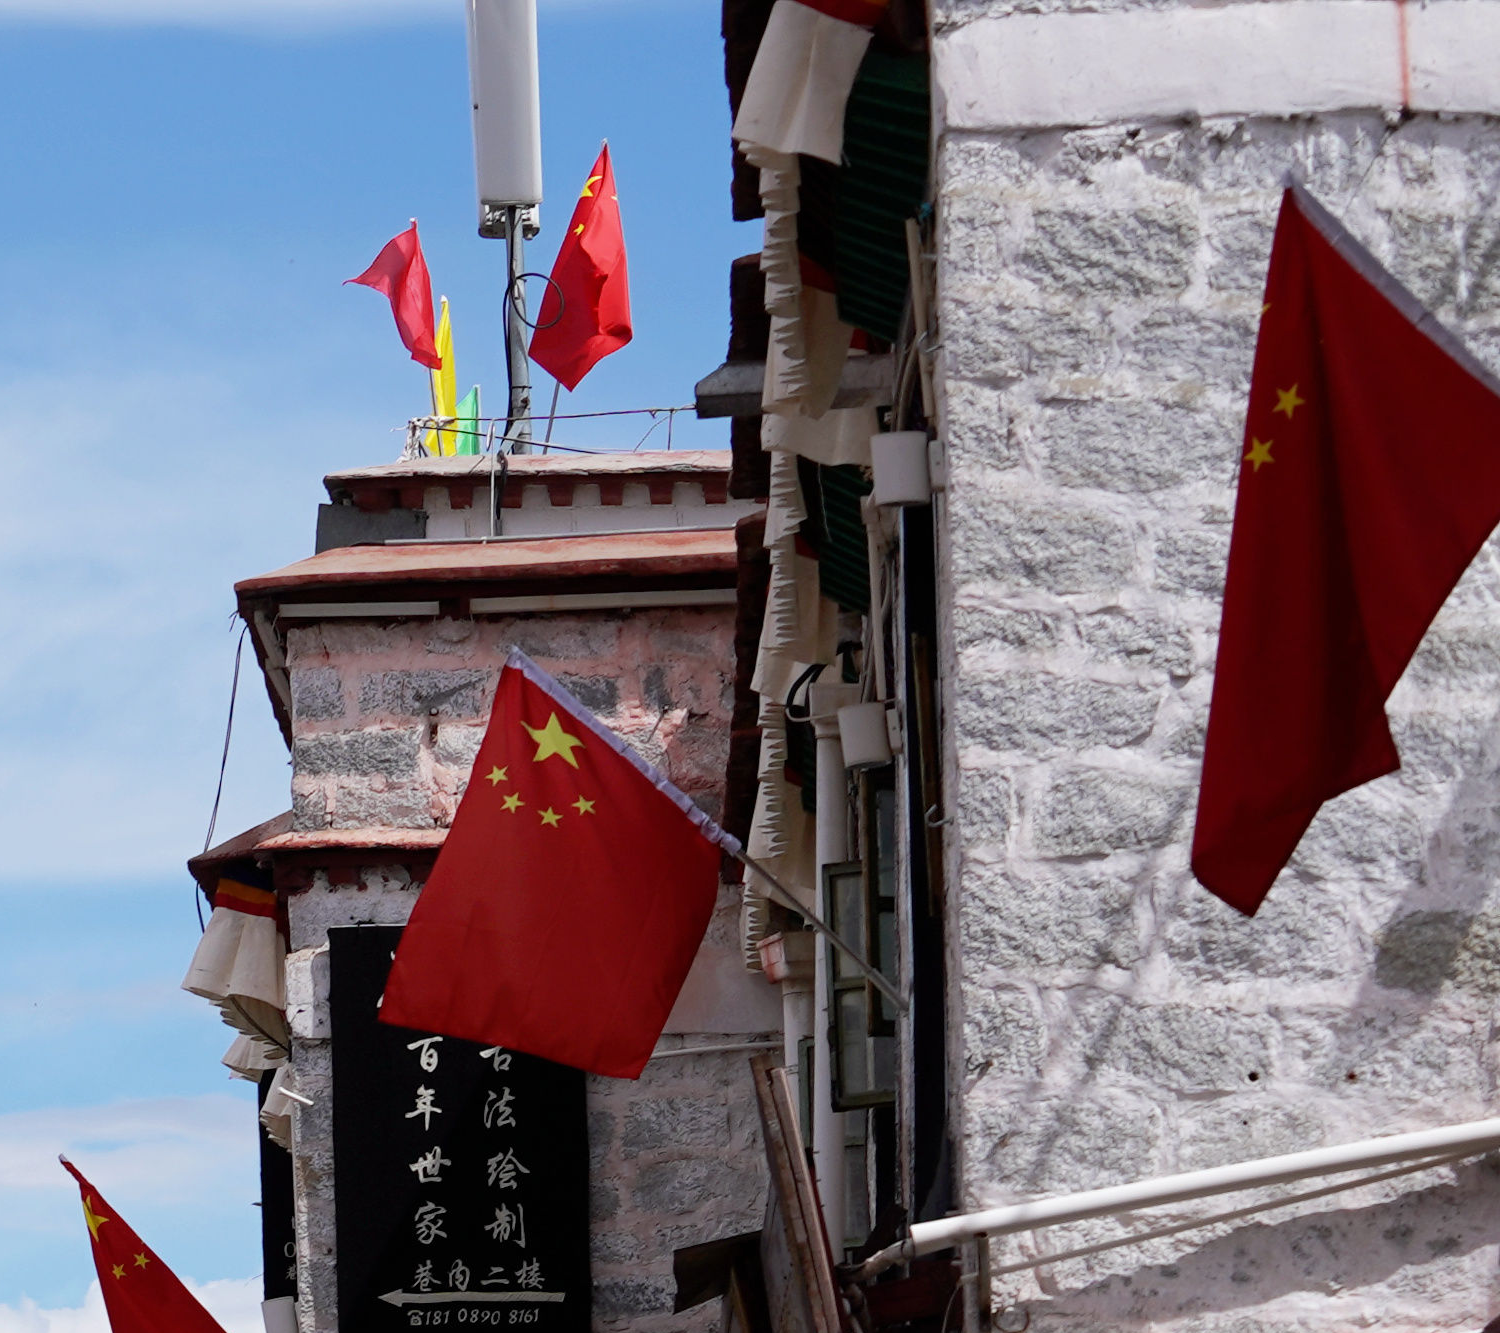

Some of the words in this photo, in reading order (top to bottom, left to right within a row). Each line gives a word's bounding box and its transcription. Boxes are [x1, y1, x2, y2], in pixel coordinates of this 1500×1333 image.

[404, 1035, 452, 1246] 百年世家
[478, 1043, 531, 1249] 古法绘制
[411, 1256, 546, 1292] 巷内二楼
[426, 1310, 450, 1326] 181
[457, 1308, 501, 1325] 0890
